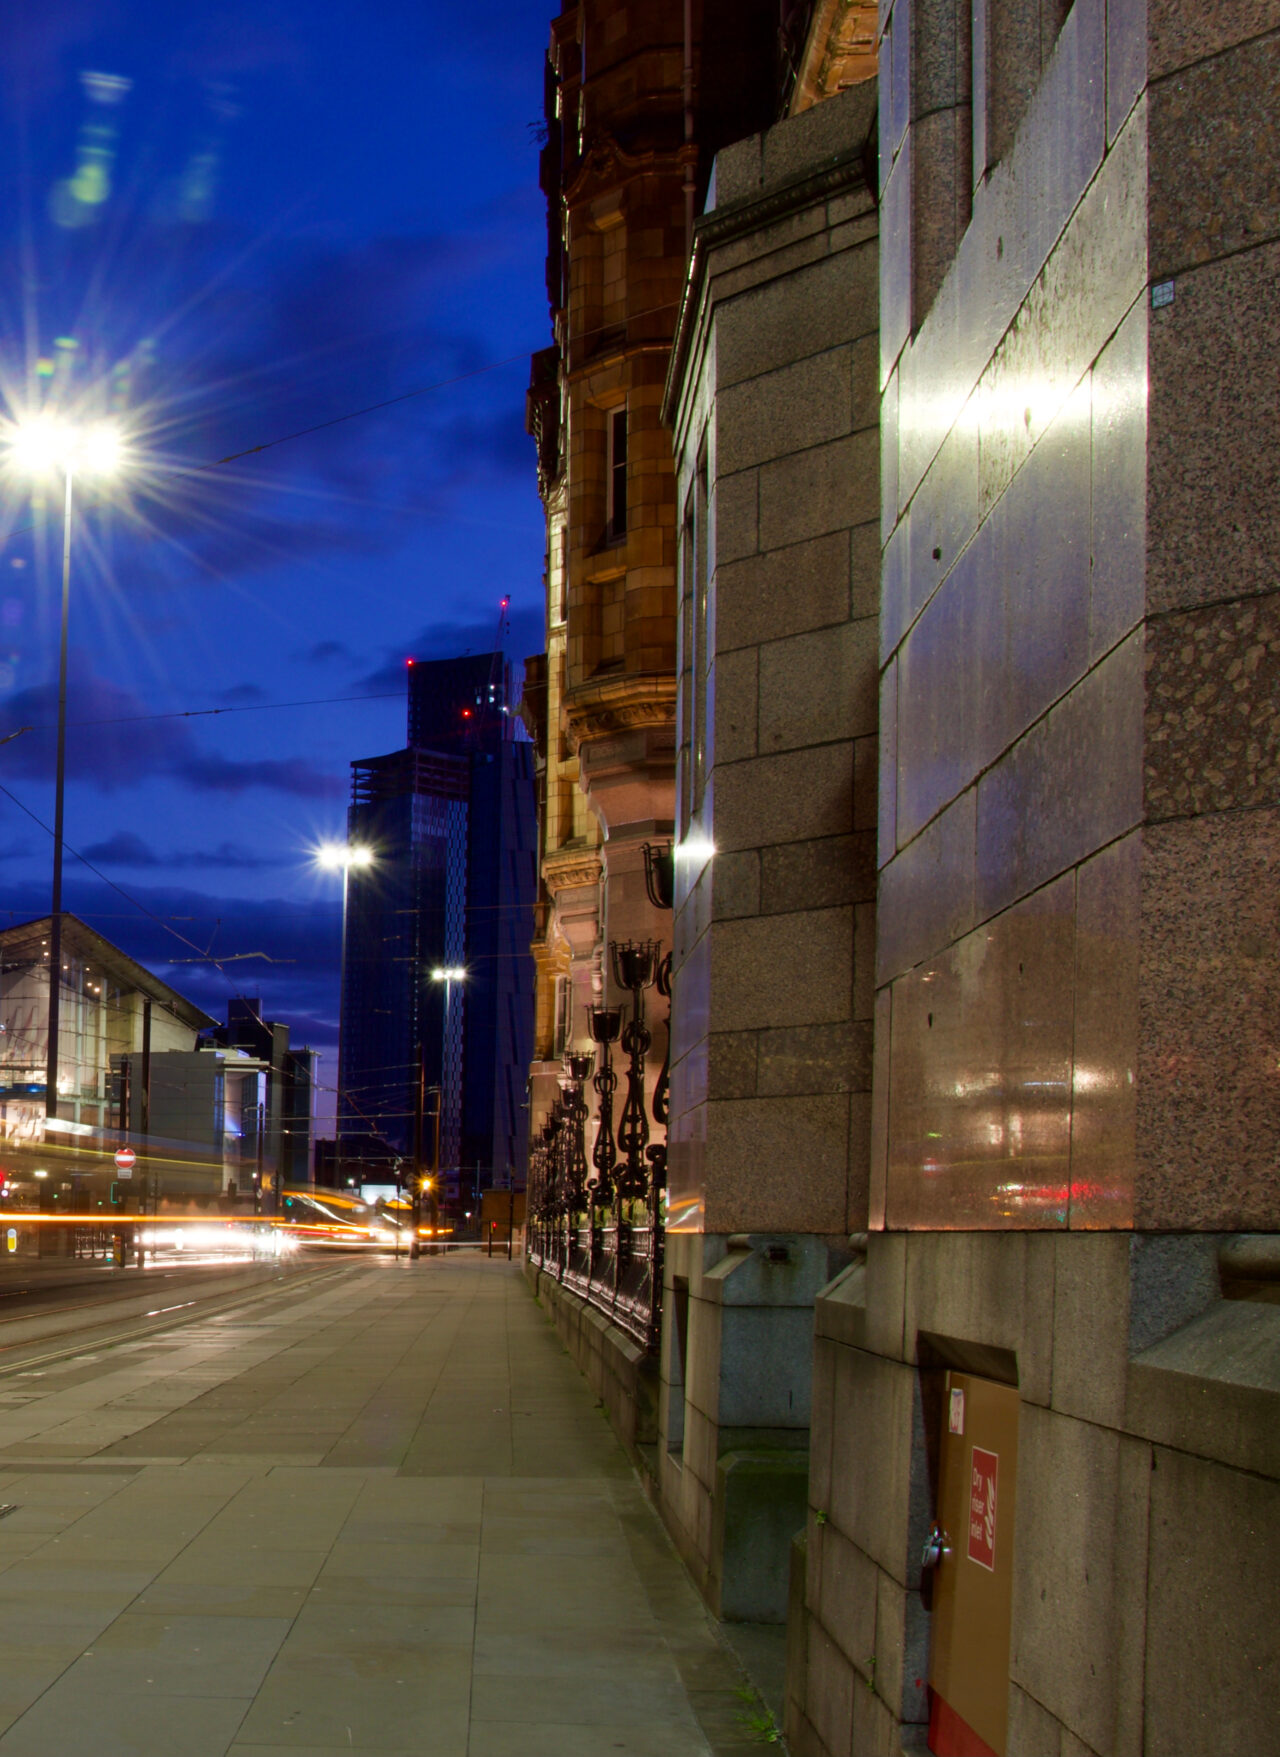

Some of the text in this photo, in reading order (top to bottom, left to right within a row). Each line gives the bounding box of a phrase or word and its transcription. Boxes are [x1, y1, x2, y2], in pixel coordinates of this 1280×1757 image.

[972, 1467, 983, 1492] Dry
[971, 1494, 984, 1515] riser
[970, 1518, 983, 1541] inlet
